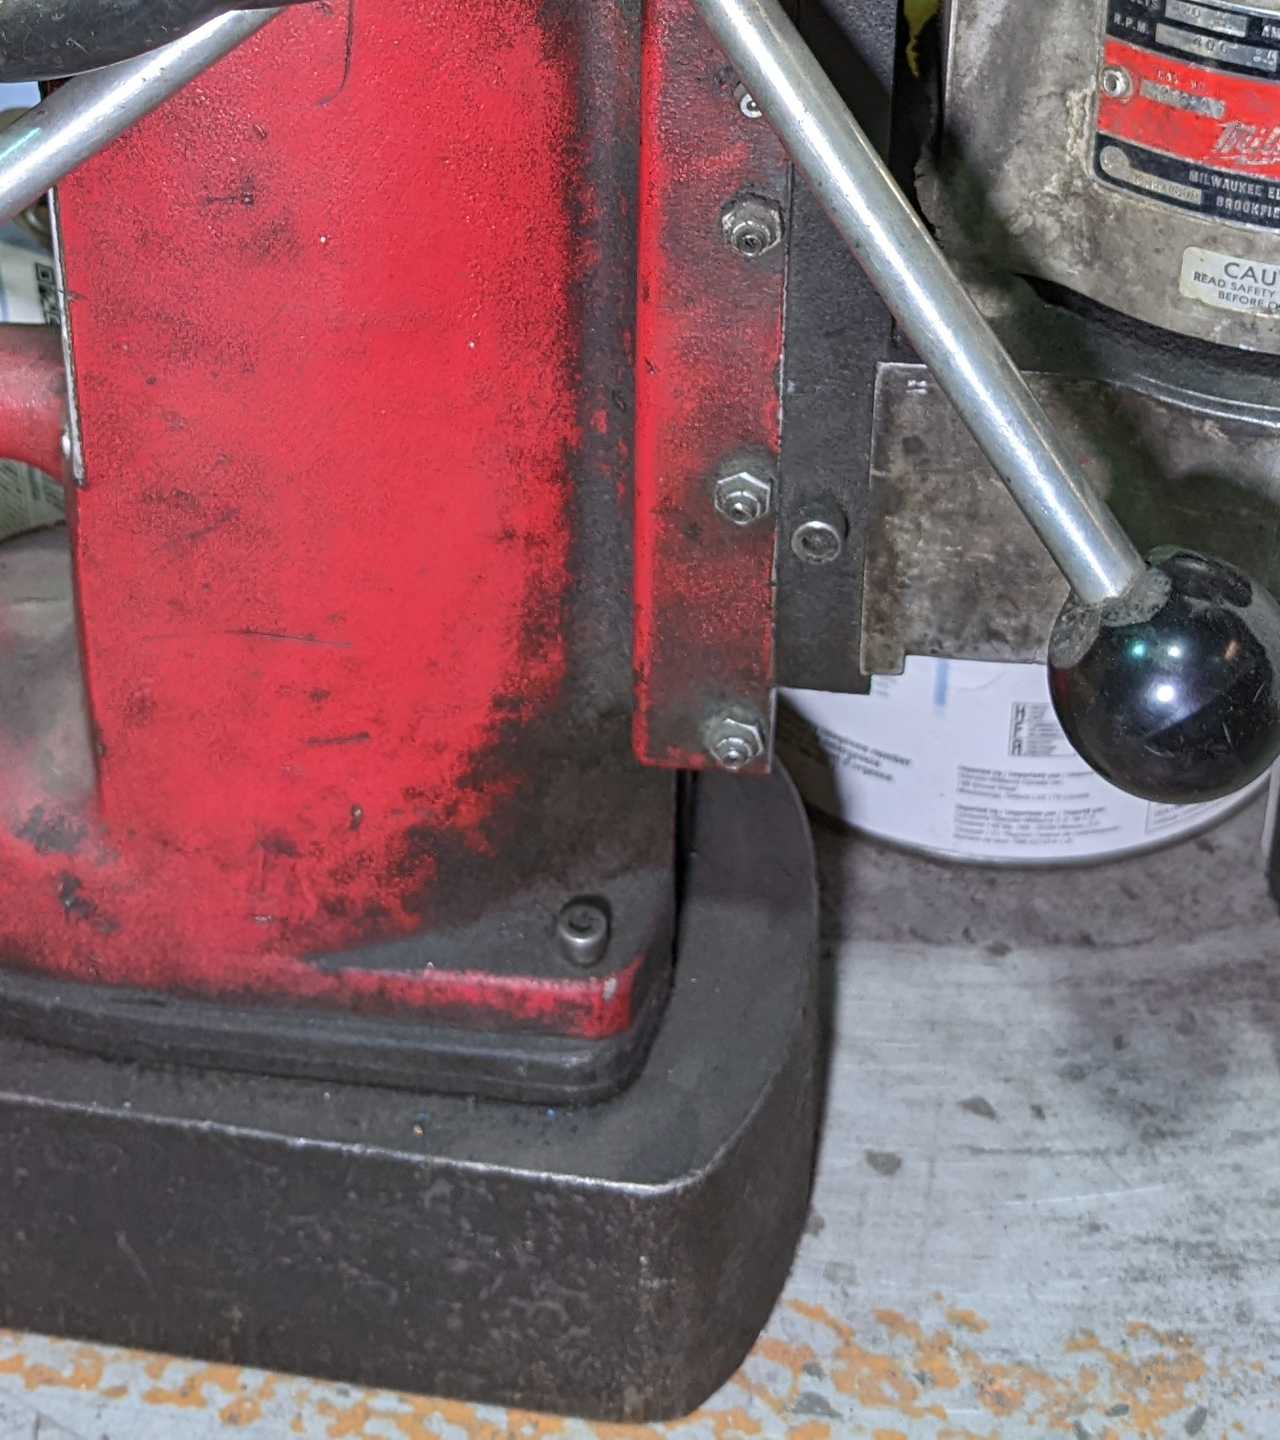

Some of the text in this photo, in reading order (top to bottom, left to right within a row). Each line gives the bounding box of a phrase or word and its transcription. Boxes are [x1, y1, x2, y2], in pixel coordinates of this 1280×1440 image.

[1188, 169, 1263, 195] MILWAUKEE
[1193, 271, 1226, 289] READ
[1231, 281, 1276, 299] SAFETY
[1218, 291, 1264, 308] BEFORE
